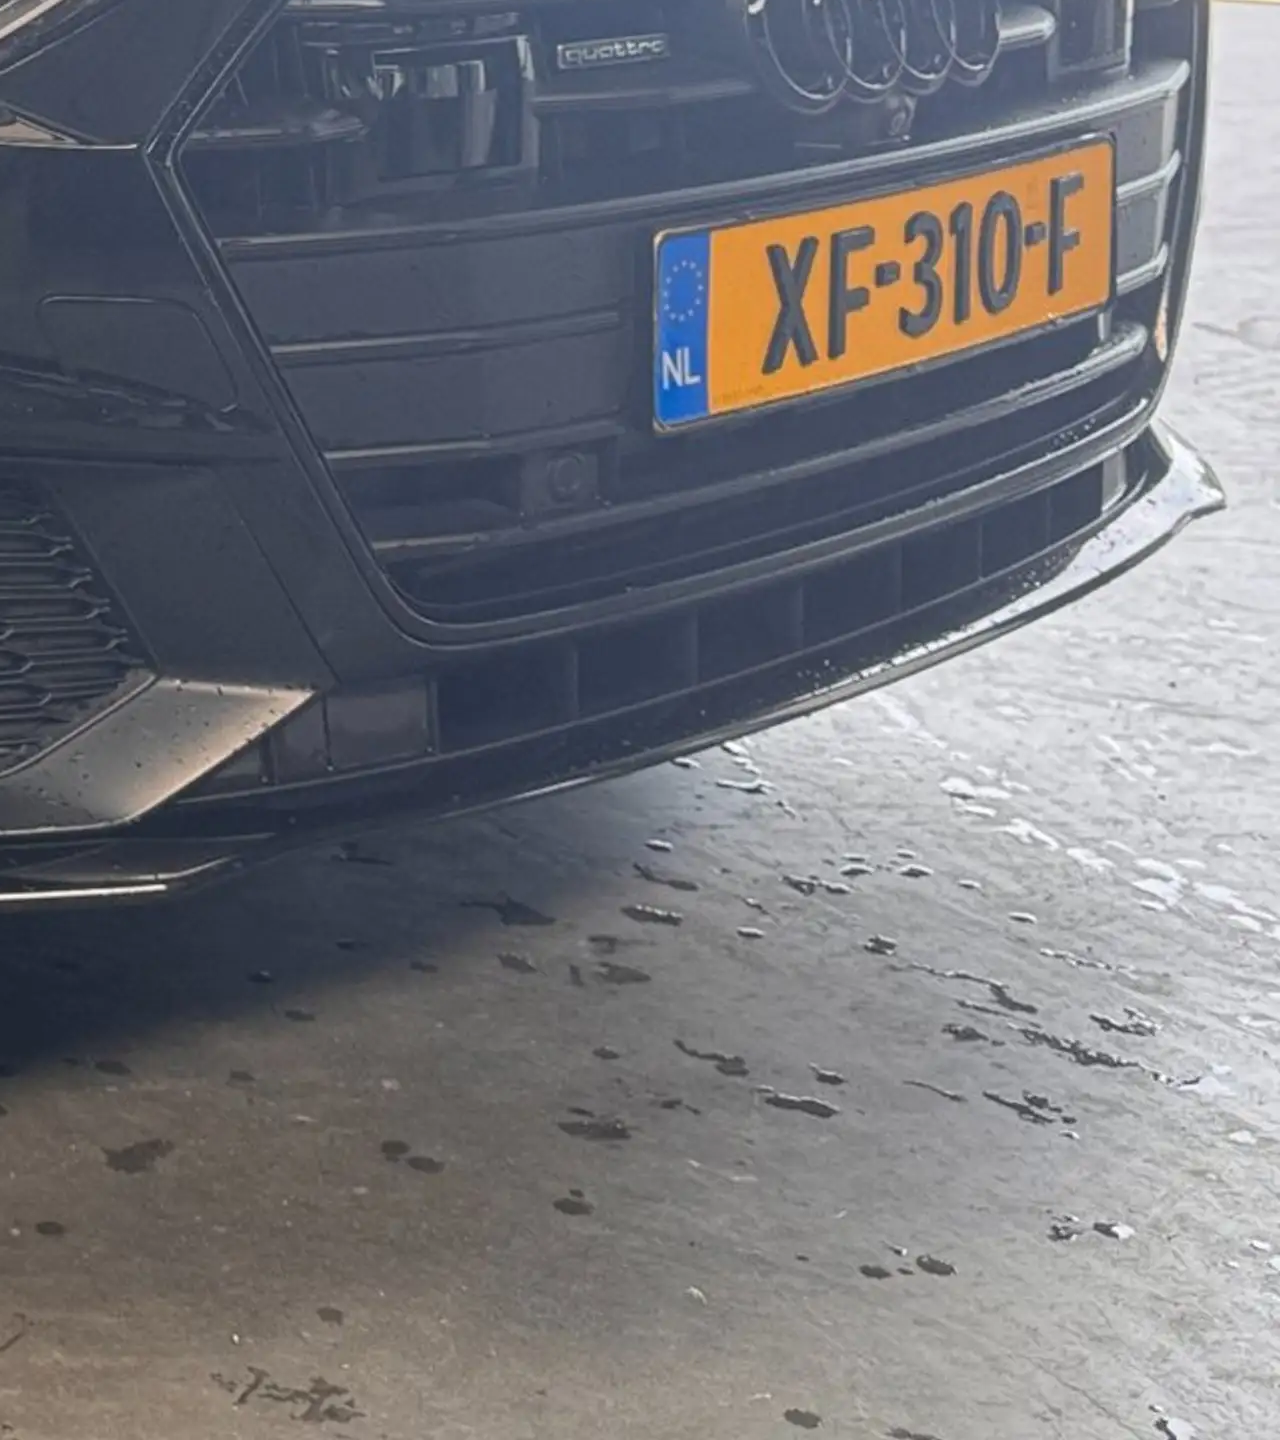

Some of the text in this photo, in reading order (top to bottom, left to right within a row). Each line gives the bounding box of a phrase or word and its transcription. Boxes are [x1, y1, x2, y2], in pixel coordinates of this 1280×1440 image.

[565, 38, 666, 66] quattro
[761, 173, 1086, 376] XF-310-F
[660, 345, 702, 392] NL
